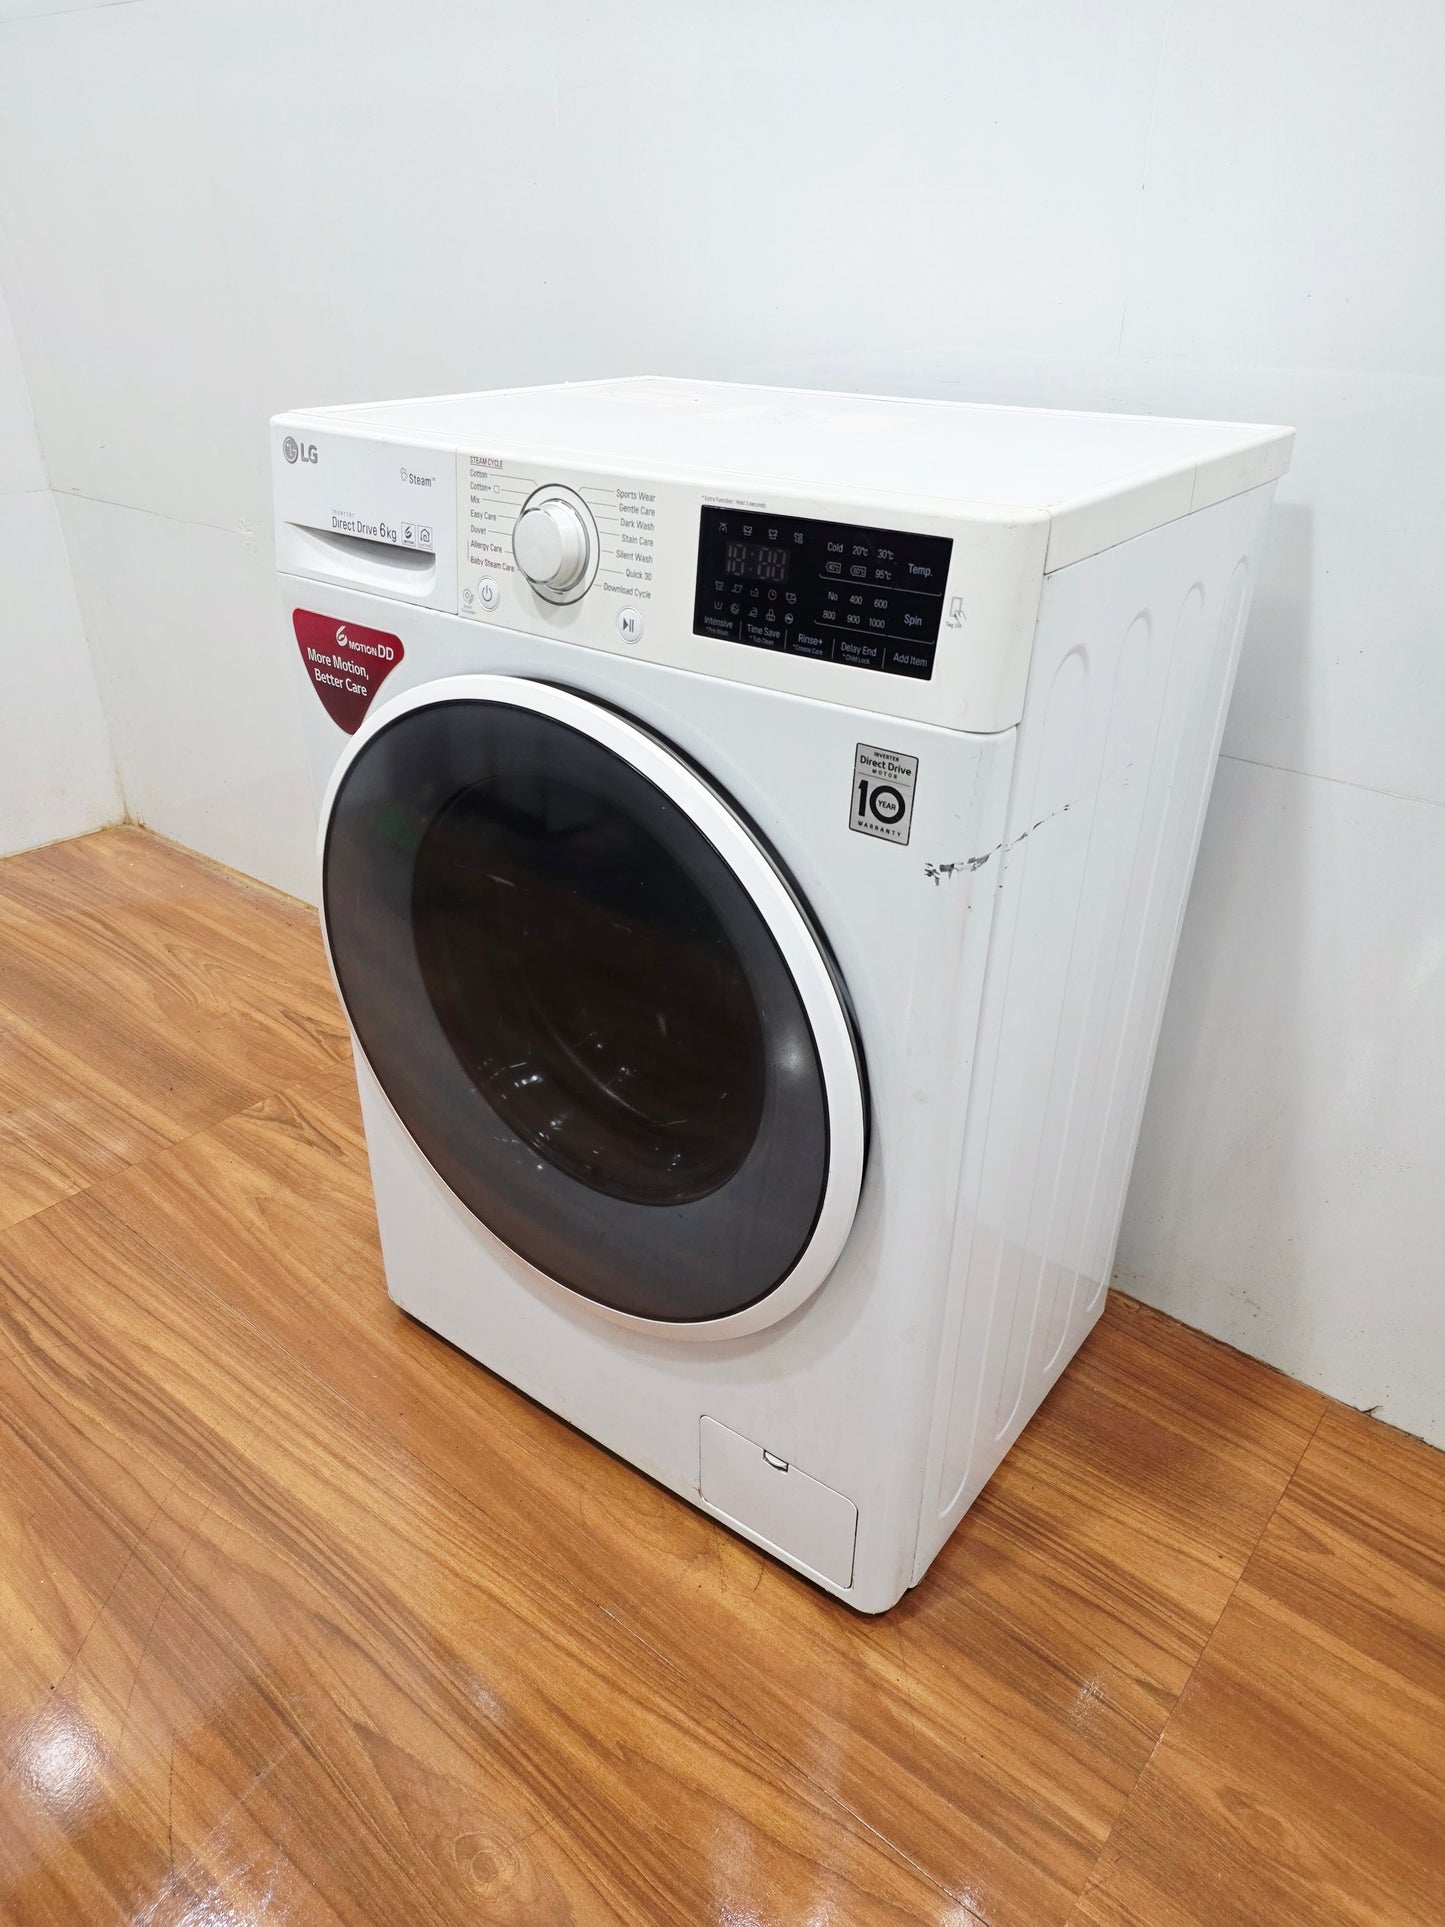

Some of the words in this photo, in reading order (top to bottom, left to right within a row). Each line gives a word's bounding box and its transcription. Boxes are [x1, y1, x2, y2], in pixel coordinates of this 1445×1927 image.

[301, 443, 318, 464] LG
[470, 456, 487, 465] STEAM
[488, 458, 503, 468] CYCLE
[470, 469, 488, 478] Cotton
[470, 482, 491, 492] Cotton+
[470, 495, 480, 504] Mix
[616, 489, 637, 500] Sports
[638, 492, 656, 502] Wear
[470, 510, 483, 520] Easy
[484, 512, 496, 521] Care
[619, 503, 639, 514] Gentle
[640, 506, 655, 516] Care
[332, 516, 356, 532] Direct
[357, 520, 378, 536] Drive
[471, 524, 486, 535] Duvet
[620, 518, 635, 528] Dark
[636, 521, 654, 531] Wash
[470, 540, 489, 552] Allergy
[490, 544, 502, 554] Care
[622, 534, 638, 544] Stain
[639, 537, 654, 547] Care
[827, 542, 844, 552] Cold
[616, 550, 634, 560] Silent
[635, 553, 653, 563] Wash
[471, 556, 484, 567] Baby
[484, 559, 501, 570] Steam
[502, 563, 514, 572] Care
[908, 562, 933, 578] Temp.
[626, 568, 643, 579] Quick
[644, 572, 652, 581] 30
[604, 582, 633, 596] Download
[634, 588, 652, 599] Cycle
[828, 592, 838, 600] No
[849, 595, 862, 605] 400
[874, 598, 888, 609] 600
[704, 616, 734, 629] Intensive
[822, 610, 836, 620] 800
[846, 614, 860, 624] 900
[869, 618, 886, 628] 1000
[904, 614, 922, 626] Spin
[746, 624, 762, 635] Time
[764, 627, 780, 638] Save
[798, 633, 823, 646] Rinse+
[840, 642, 862, 655] Delay
[862, 645, 877, 657] End
[307, 647, 332, 666] More
[332, 655, 369, 680] Motion,
[892, 652, 908, 664] Add
[910, 656, 928, 667] Item
[314, 668, 344, 689] Better
[345, 678, 368, 696] Care
[874, 752, 900, 762] INVERTER
[860, 755, 886, 770] Direct
[888, 762, 912, 776] Drive
[872, 769, 898, 779] MOTOR
[858, 779, 906, 824] 10
[878, 800, 896, 811] YEAR
[858, 820, 901, 838] WARRANTY
